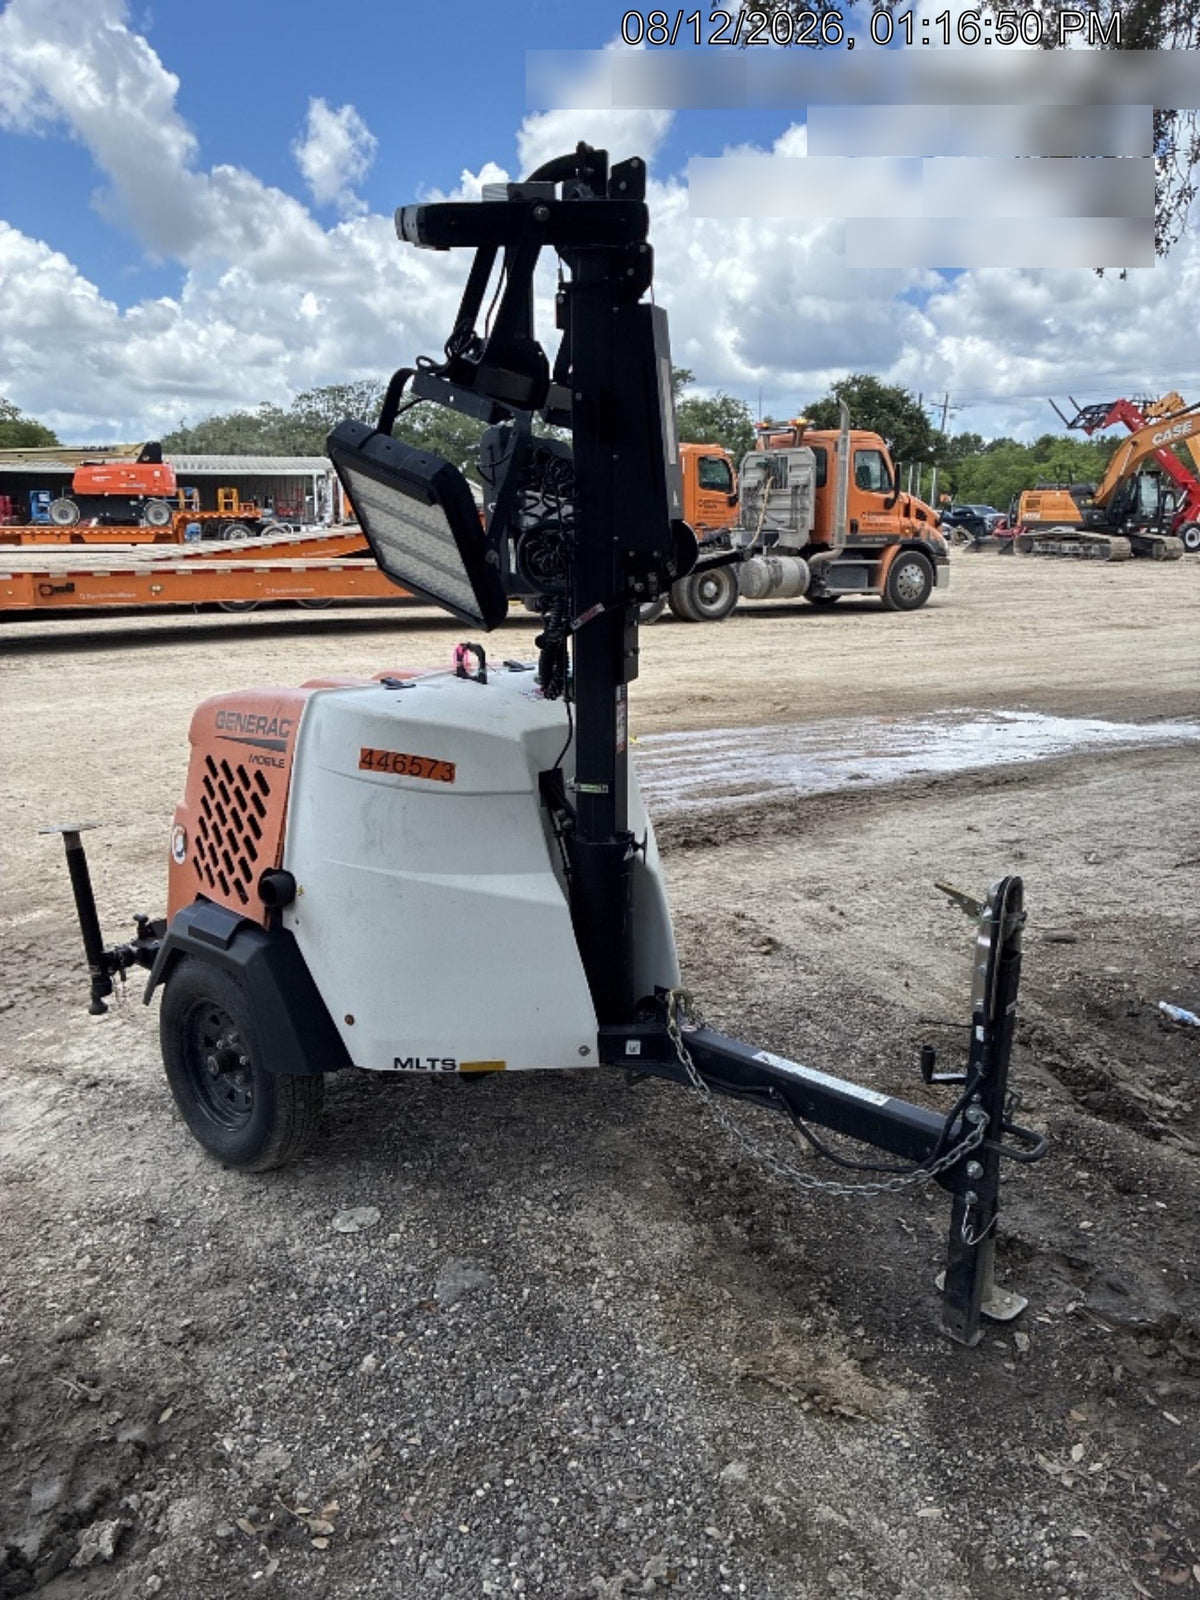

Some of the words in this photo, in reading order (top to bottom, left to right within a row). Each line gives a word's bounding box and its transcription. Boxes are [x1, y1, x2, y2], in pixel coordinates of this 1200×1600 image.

[1152, 419, 1193, 446] CASE
[215, 710, 291, 738] GENERAC
[361, 749, 456, 782] 446573
[394, 1057, 457, 1071] MLTS
